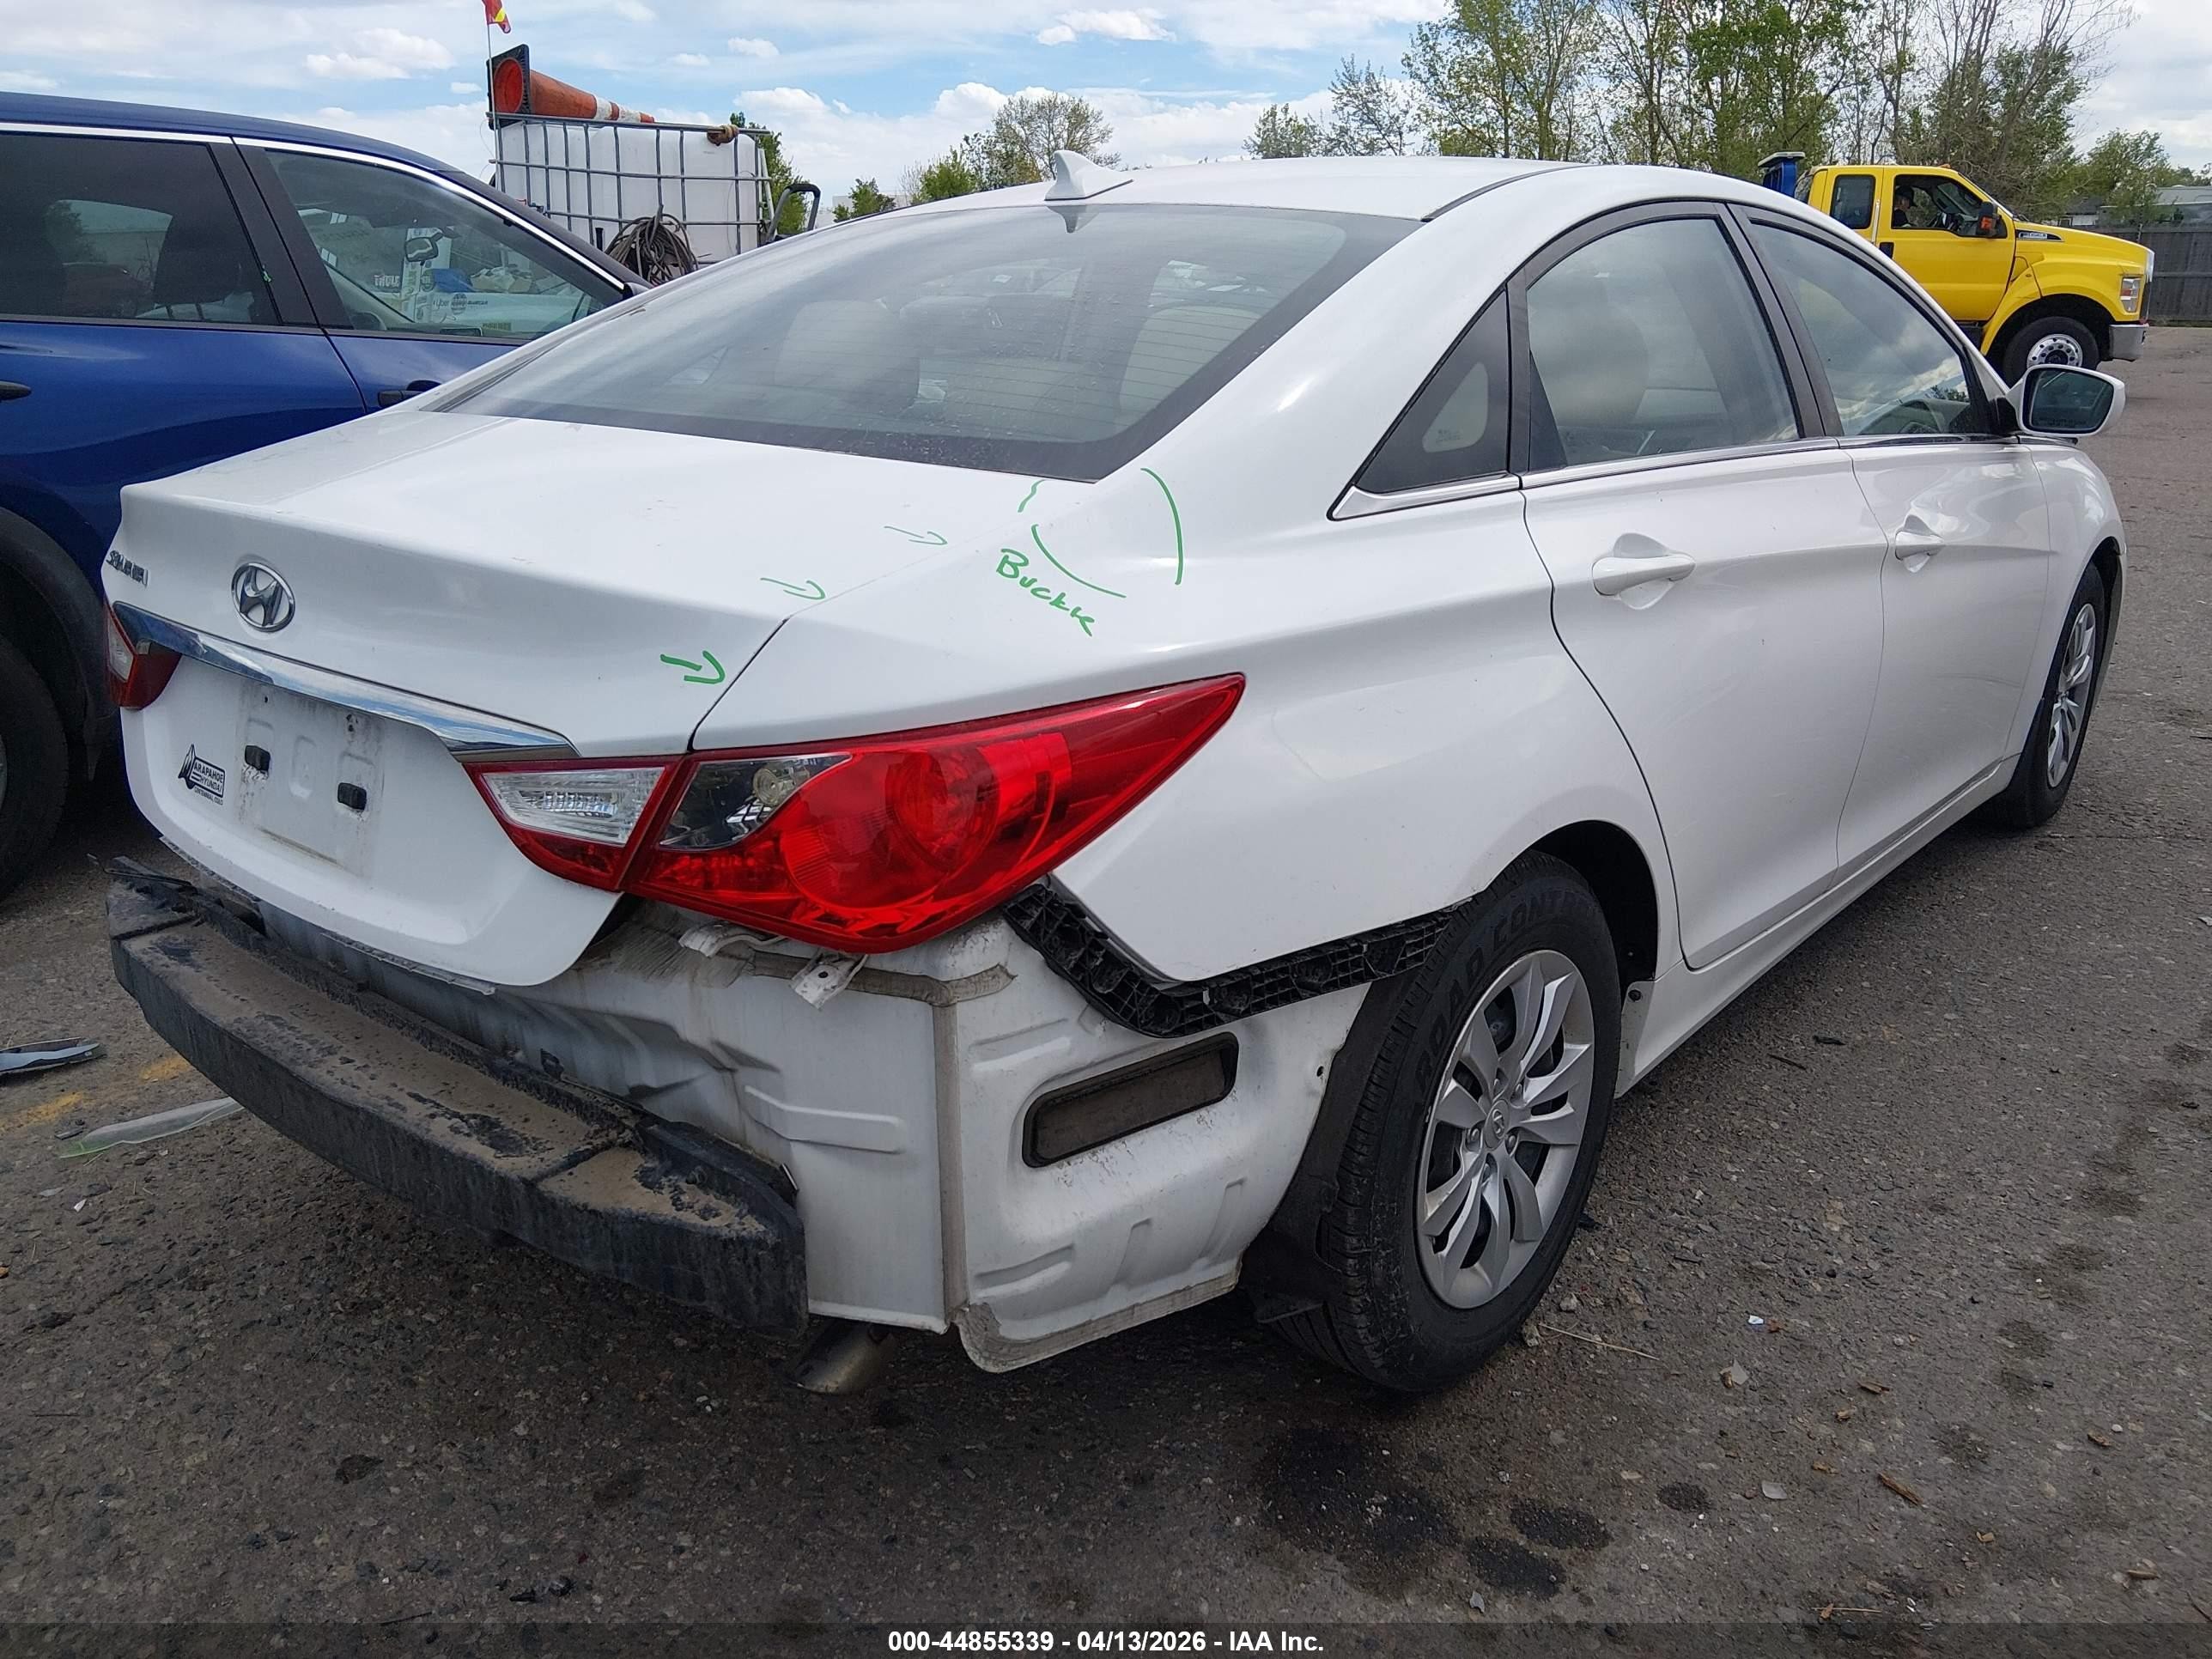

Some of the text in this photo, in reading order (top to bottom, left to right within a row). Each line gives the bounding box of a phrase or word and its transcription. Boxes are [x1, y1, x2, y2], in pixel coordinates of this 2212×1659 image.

[194, 762, 224, 784] ARAPAHOE
[198, 775, 222, 793] HYUNDAI
[1414, 945, 1485, 1092] ROAD
